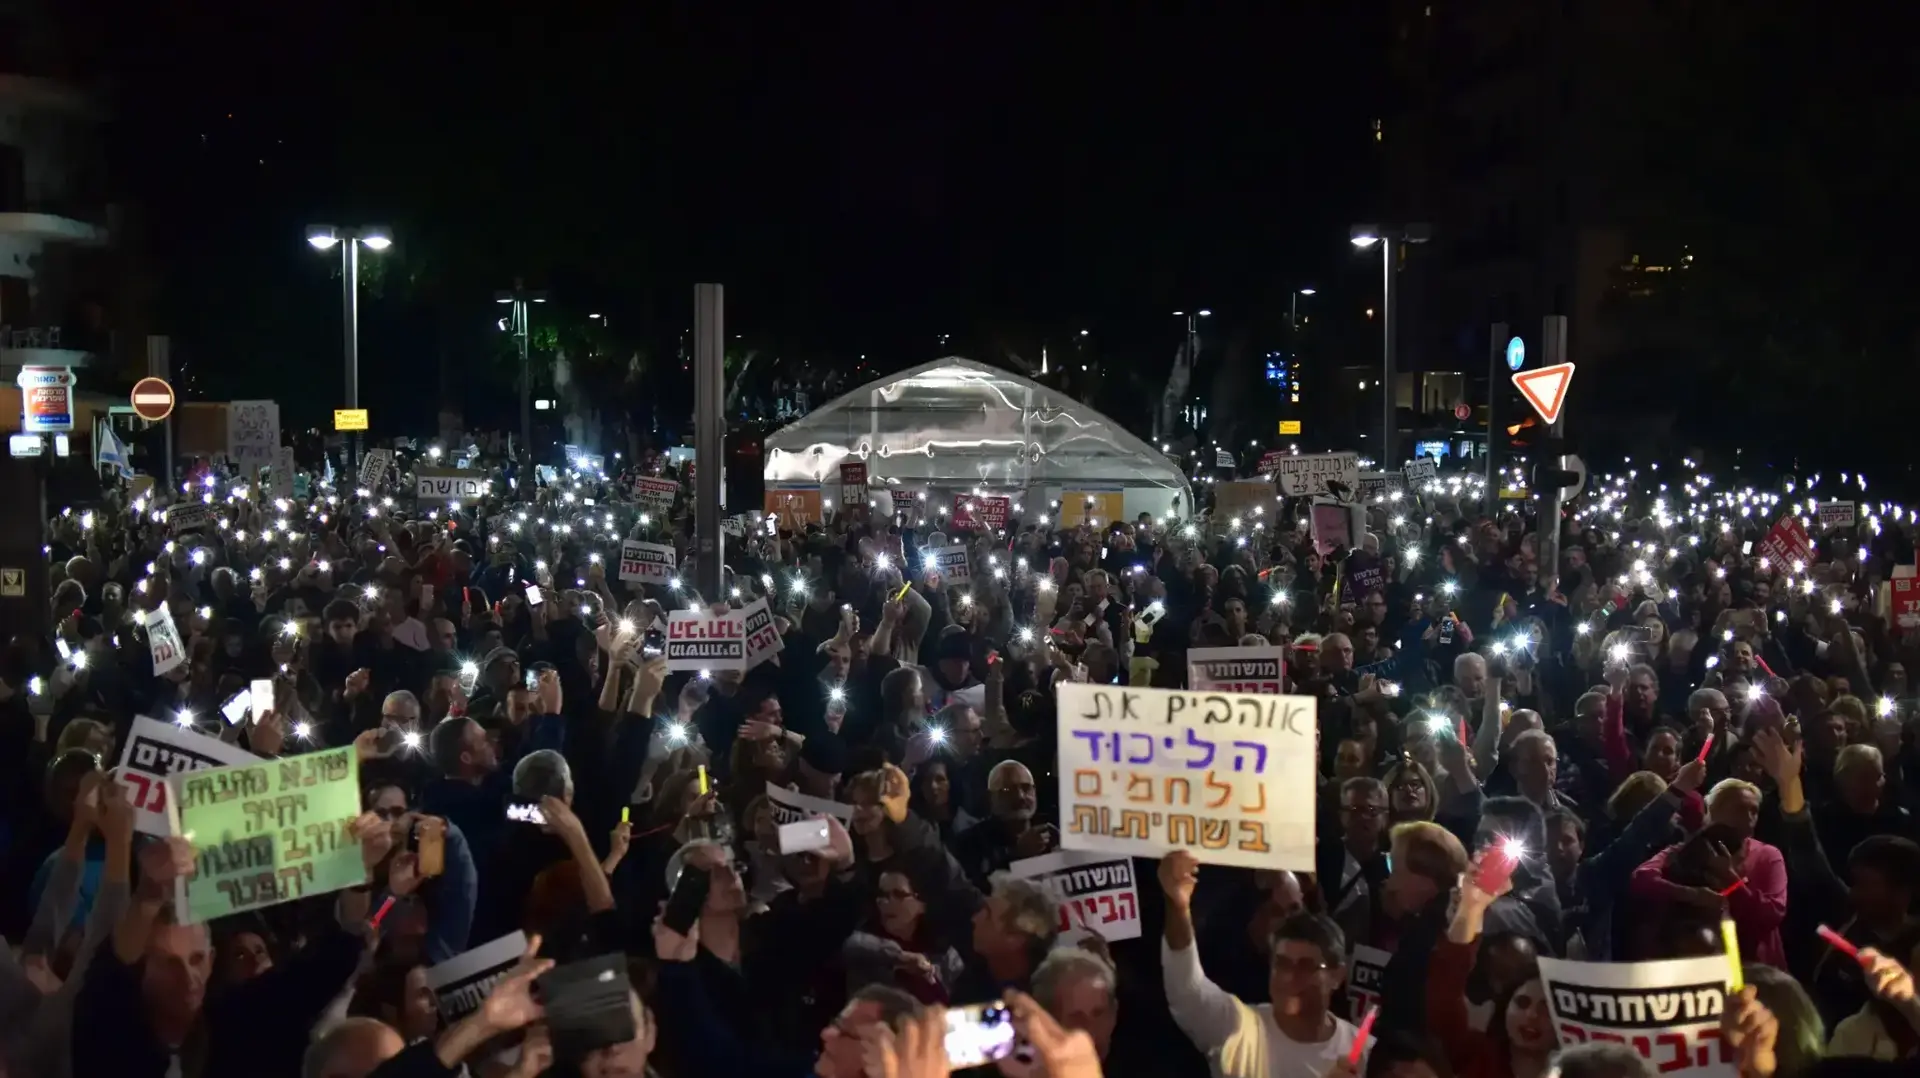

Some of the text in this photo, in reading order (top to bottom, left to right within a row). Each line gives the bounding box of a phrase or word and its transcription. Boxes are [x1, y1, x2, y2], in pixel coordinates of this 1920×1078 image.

[421, 480, 477, 495] בושה
[670, 620, 743, 639] הביתה
[1206, 661, 1278, 678] מושחתי
[1081, 691, 1141, 720] את
[1071, 727, 1268, 773] הליכוד
[1075, 770, 1267, 814] נלחמים
[1067, 804, 1271, 854] בשחיתות
[1554, 987, 1725, 1022] מושחתים
